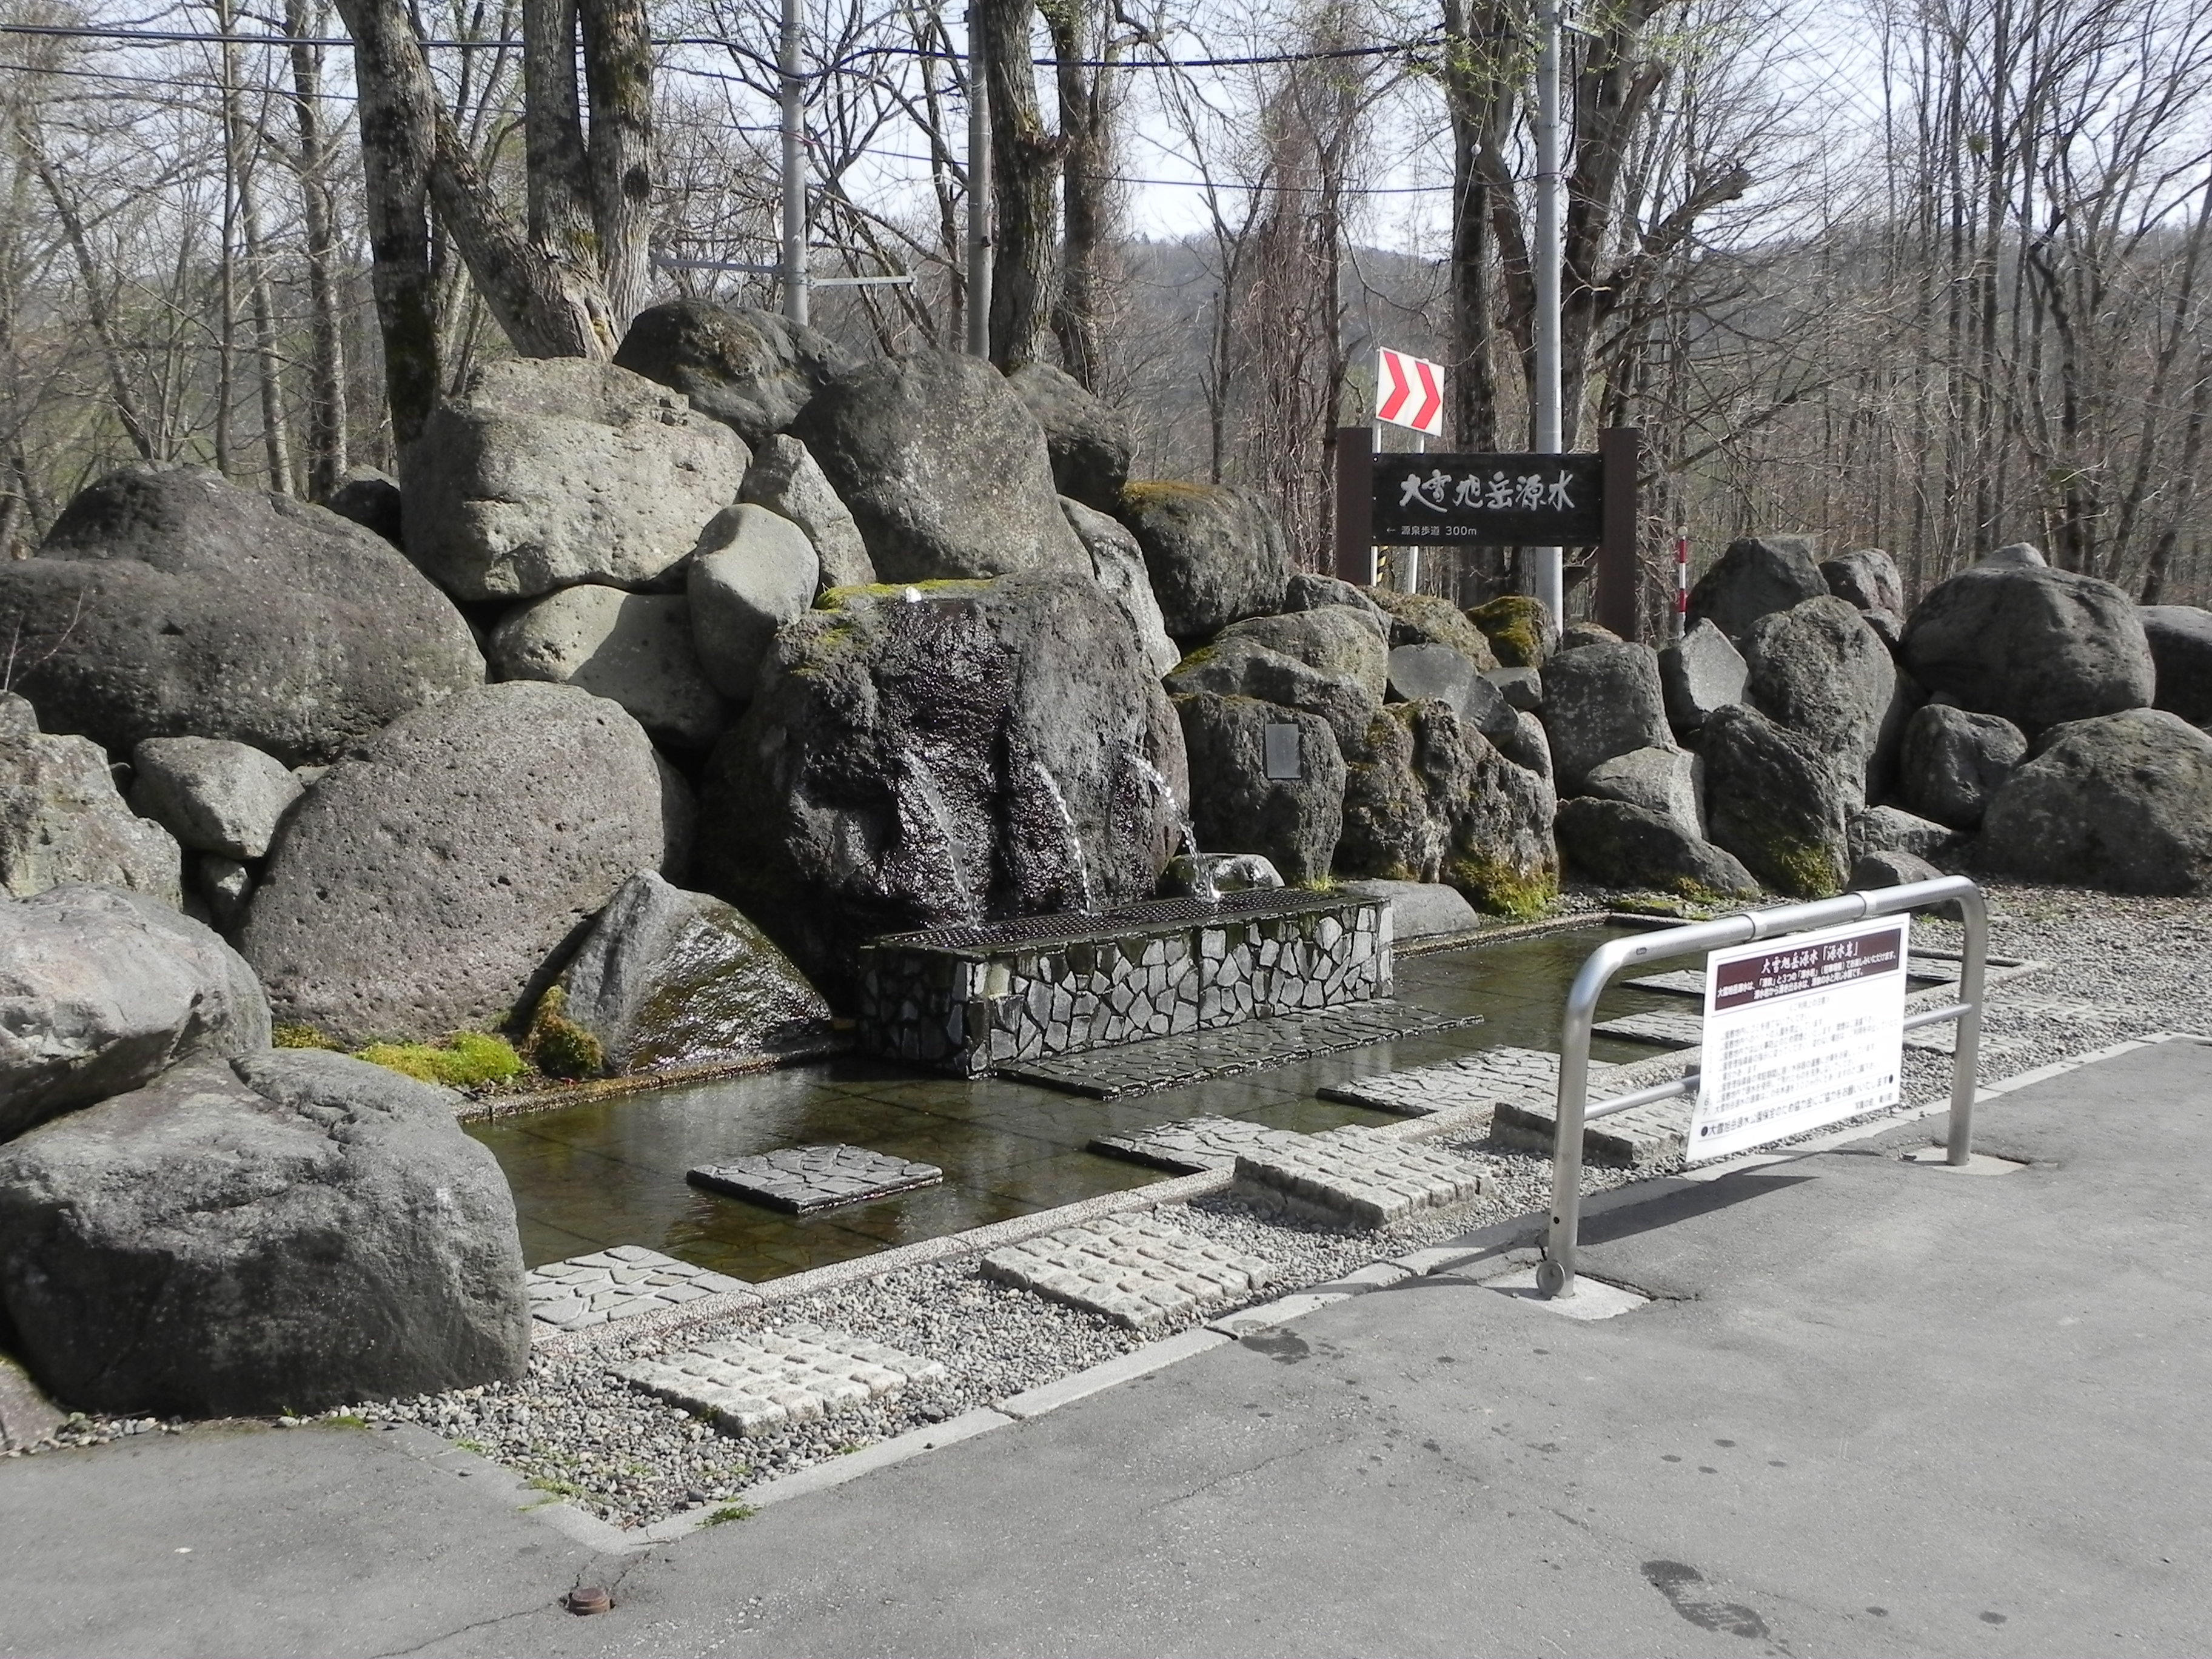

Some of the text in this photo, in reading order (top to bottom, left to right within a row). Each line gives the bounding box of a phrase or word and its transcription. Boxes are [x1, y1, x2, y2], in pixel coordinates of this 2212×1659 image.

[1399, 469, 1575, 513] 大雪旭岳源水
[1401, 525, 1476, 535] 源泉歩道 300m
